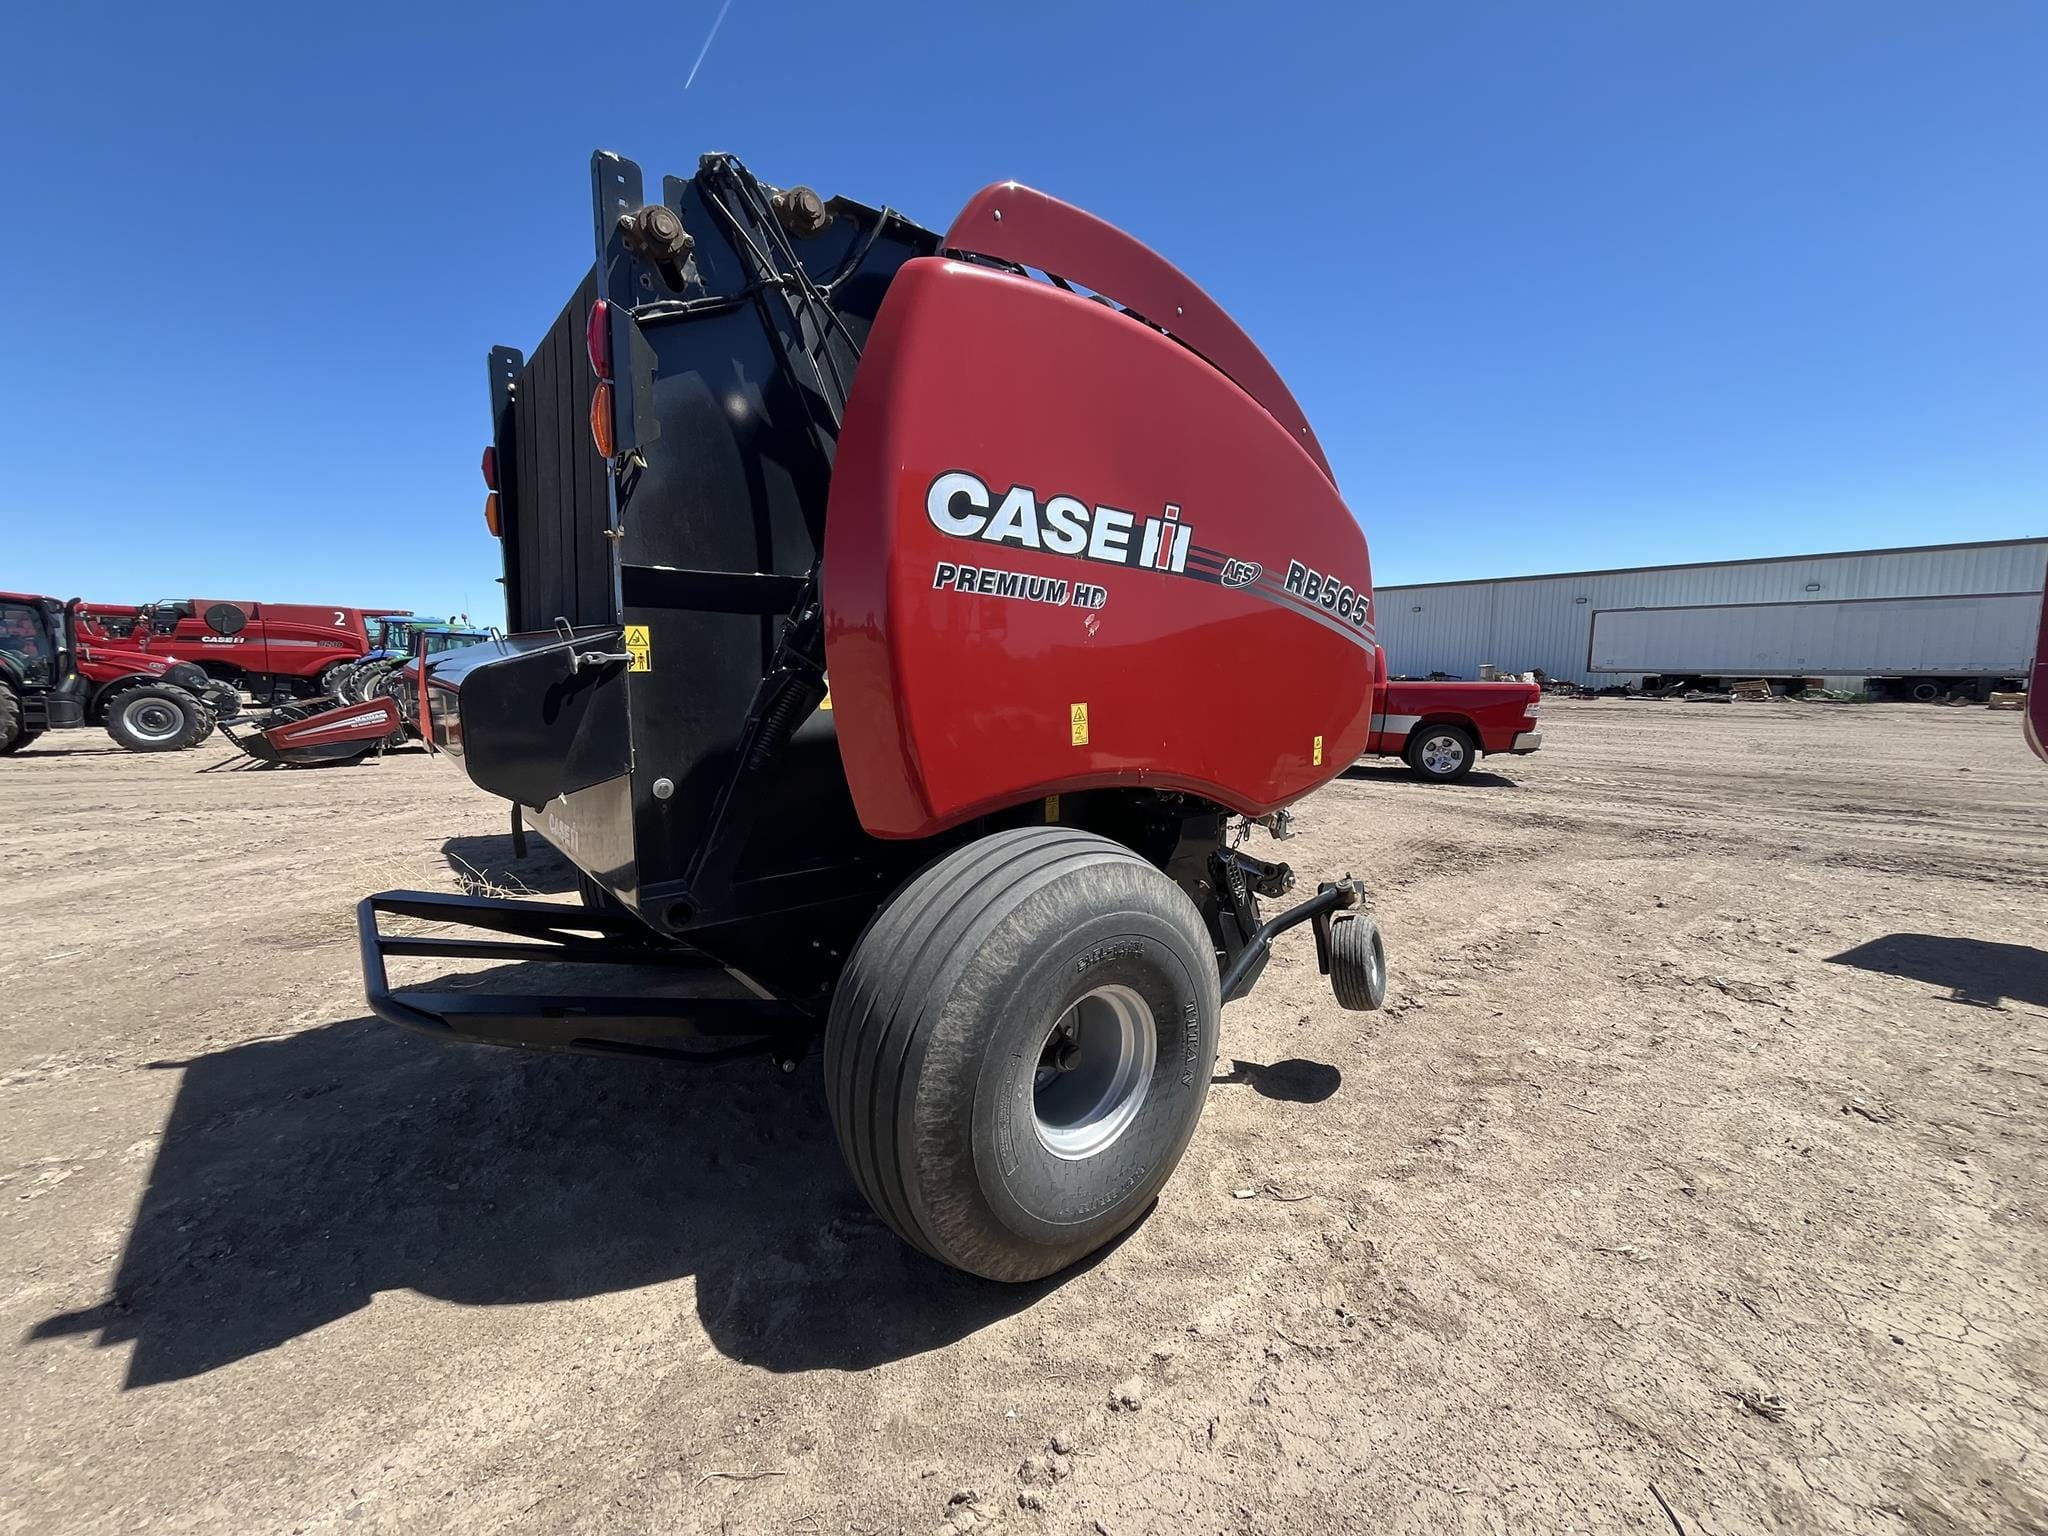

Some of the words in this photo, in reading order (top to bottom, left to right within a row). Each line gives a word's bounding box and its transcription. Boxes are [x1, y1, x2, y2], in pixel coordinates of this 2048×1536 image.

[928, 473, 1134, 563] CASE
[933, 562, 1068, 606] PREMIUM
[1072, 583, 1107, 609] HD
[1221, 558, 1255, 583] AFS
[1284, 559, 1369, 627] RB565
[334, 612, 346, 626] 2
[1182, 999, 1199, 1090] TITAN
